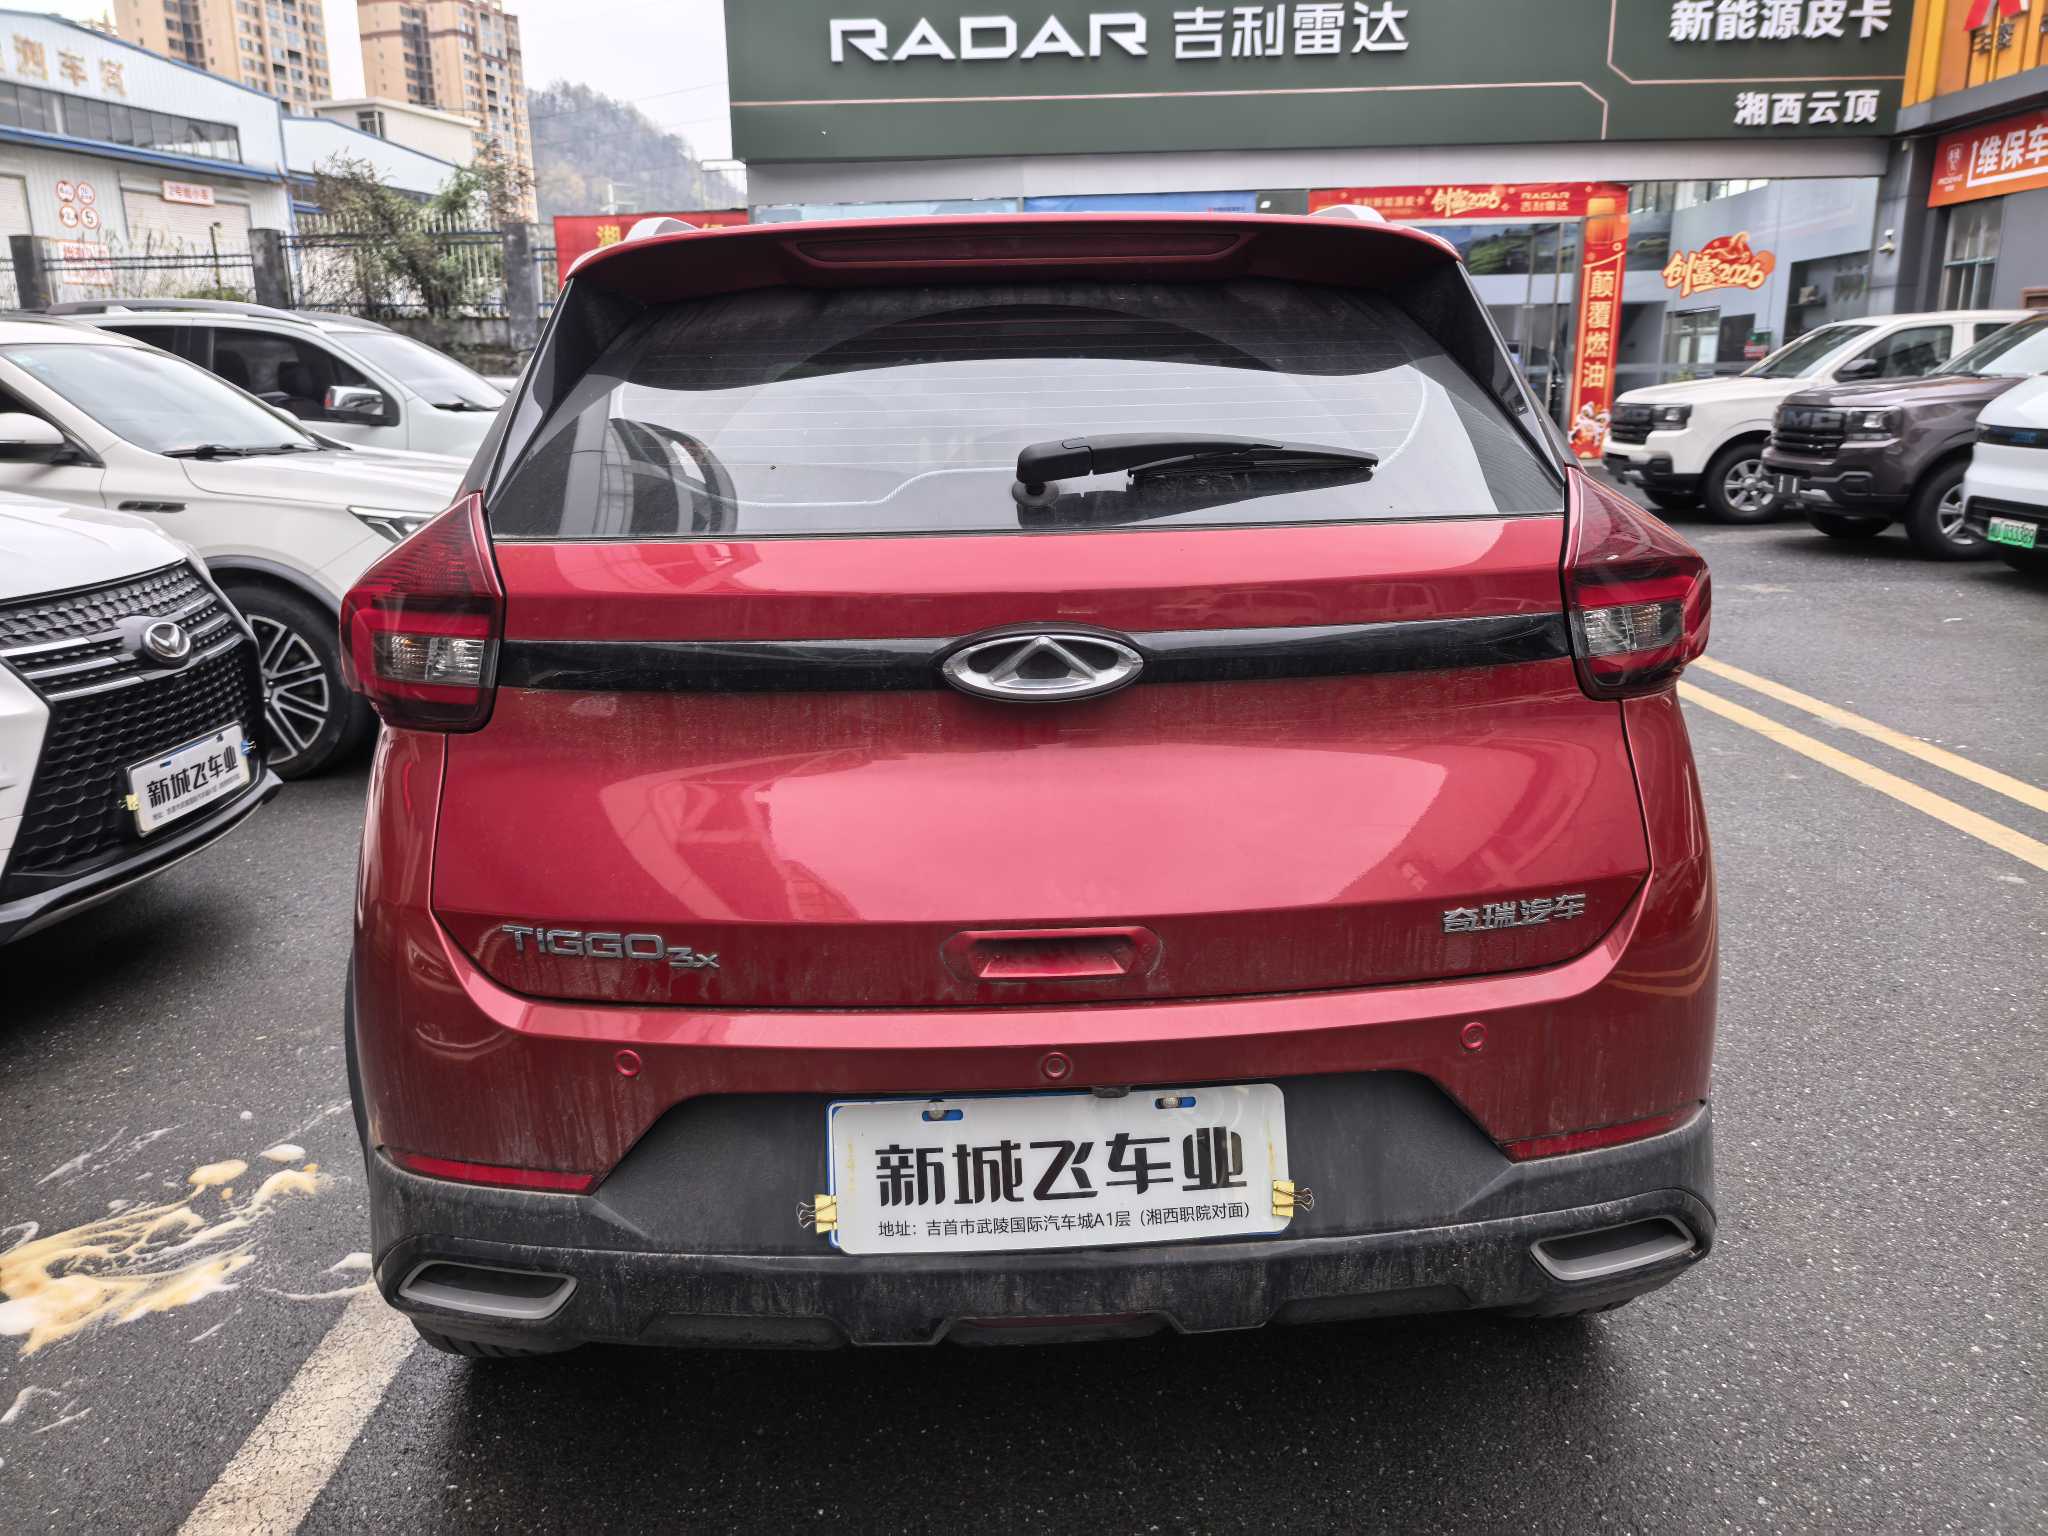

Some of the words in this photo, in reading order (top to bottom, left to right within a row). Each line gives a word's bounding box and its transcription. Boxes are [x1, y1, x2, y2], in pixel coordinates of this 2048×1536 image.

[829, 13, 1148, 62] RADAR
[1173, 3, 1409, 60] 吉利雷达
[1669, 0, 1892, 41] 新能源皮卡
[1734, 89, 1880, 125] 湘西云顶
[1521, 192, 1569, 200] RADAR
[1582, 270, 1615, 388] 颠覆燃油
[146, 745, 239, 809] 新城飞车业
[1442, 893, 1586, 933] 奇瑞汽车
[875, 1126, 1248, 1207] 新城飞车业
